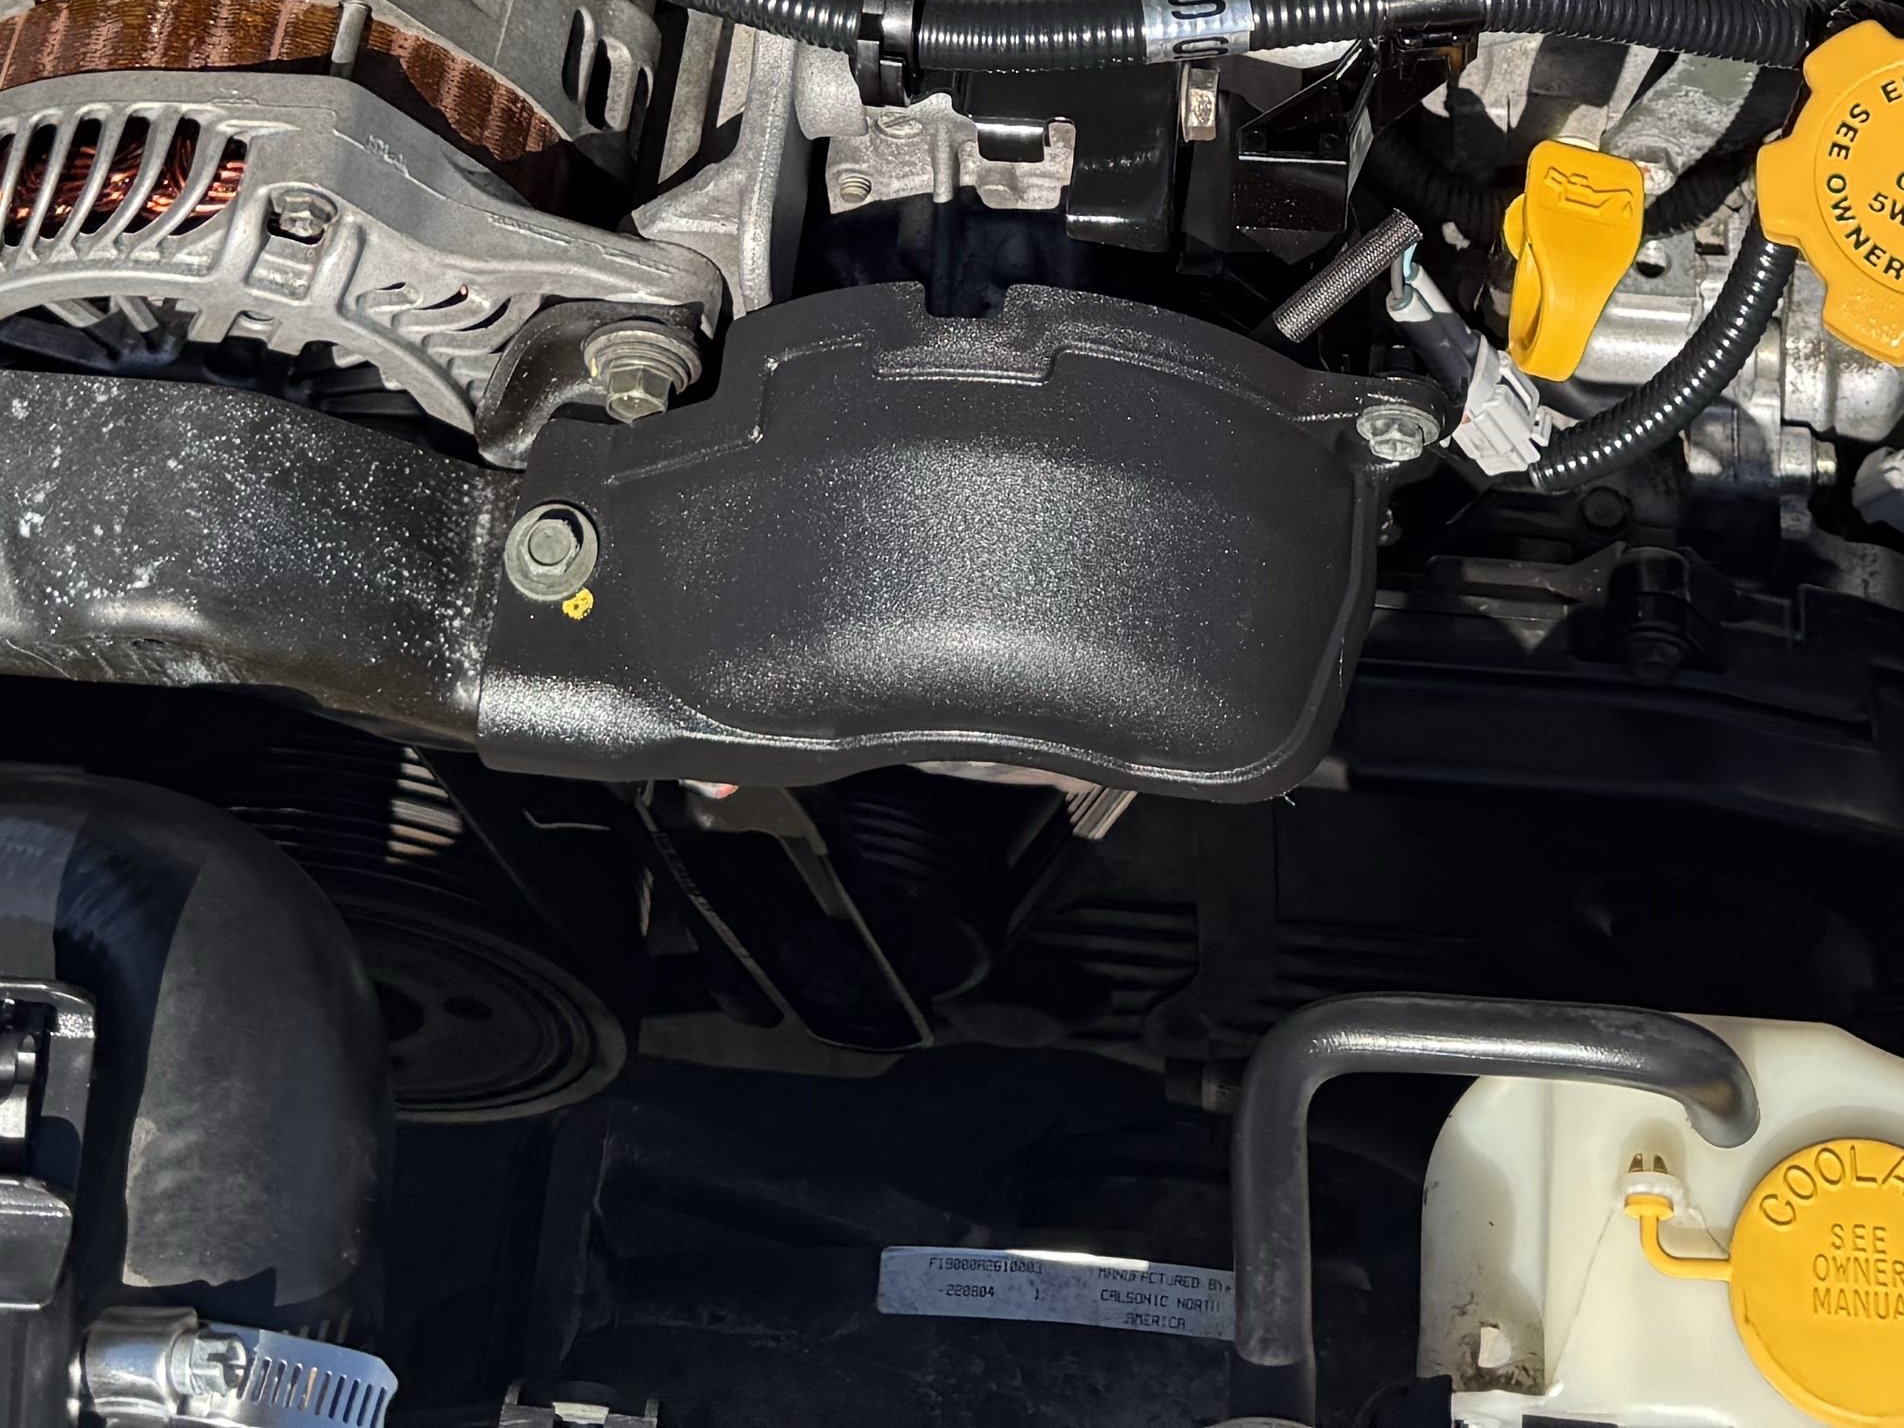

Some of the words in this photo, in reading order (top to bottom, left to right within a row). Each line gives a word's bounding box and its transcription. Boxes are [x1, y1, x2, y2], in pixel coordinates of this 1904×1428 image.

[1828, 102, 1871, 161] SEE
[1830, 1222, 1888, 1256] SEE
[1100, 1288, 1169, 1309] CALSONIC
